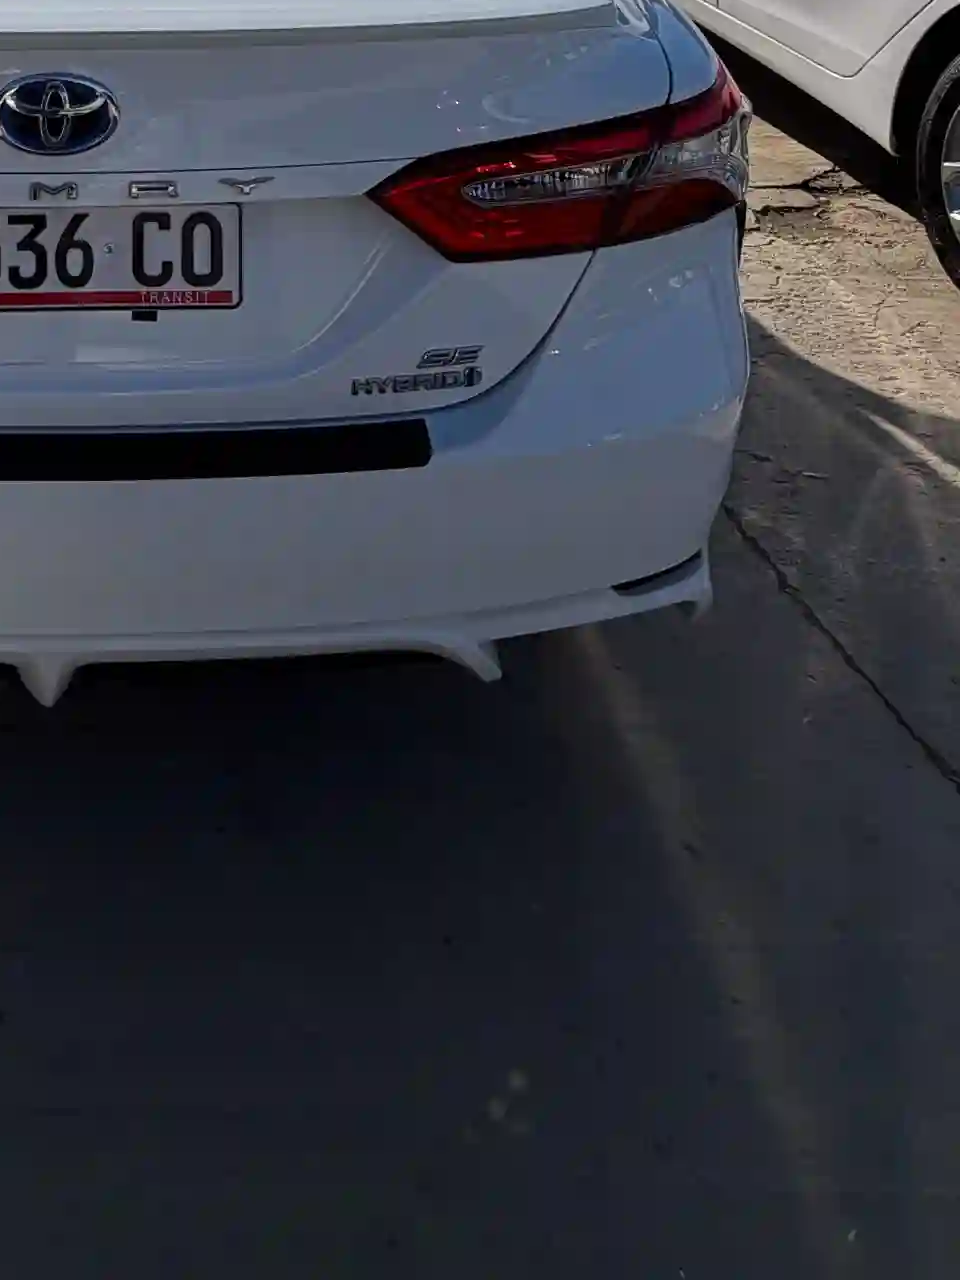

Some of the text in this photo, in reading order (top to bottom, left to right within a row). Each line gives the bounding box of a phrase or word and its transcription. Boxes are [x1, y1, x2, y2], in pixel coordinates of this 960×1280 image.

[141, 291, 208, 305] TRANSIT
[416, 345, 485, 369] SE
[350, 371, 462, 396] HYBRID
